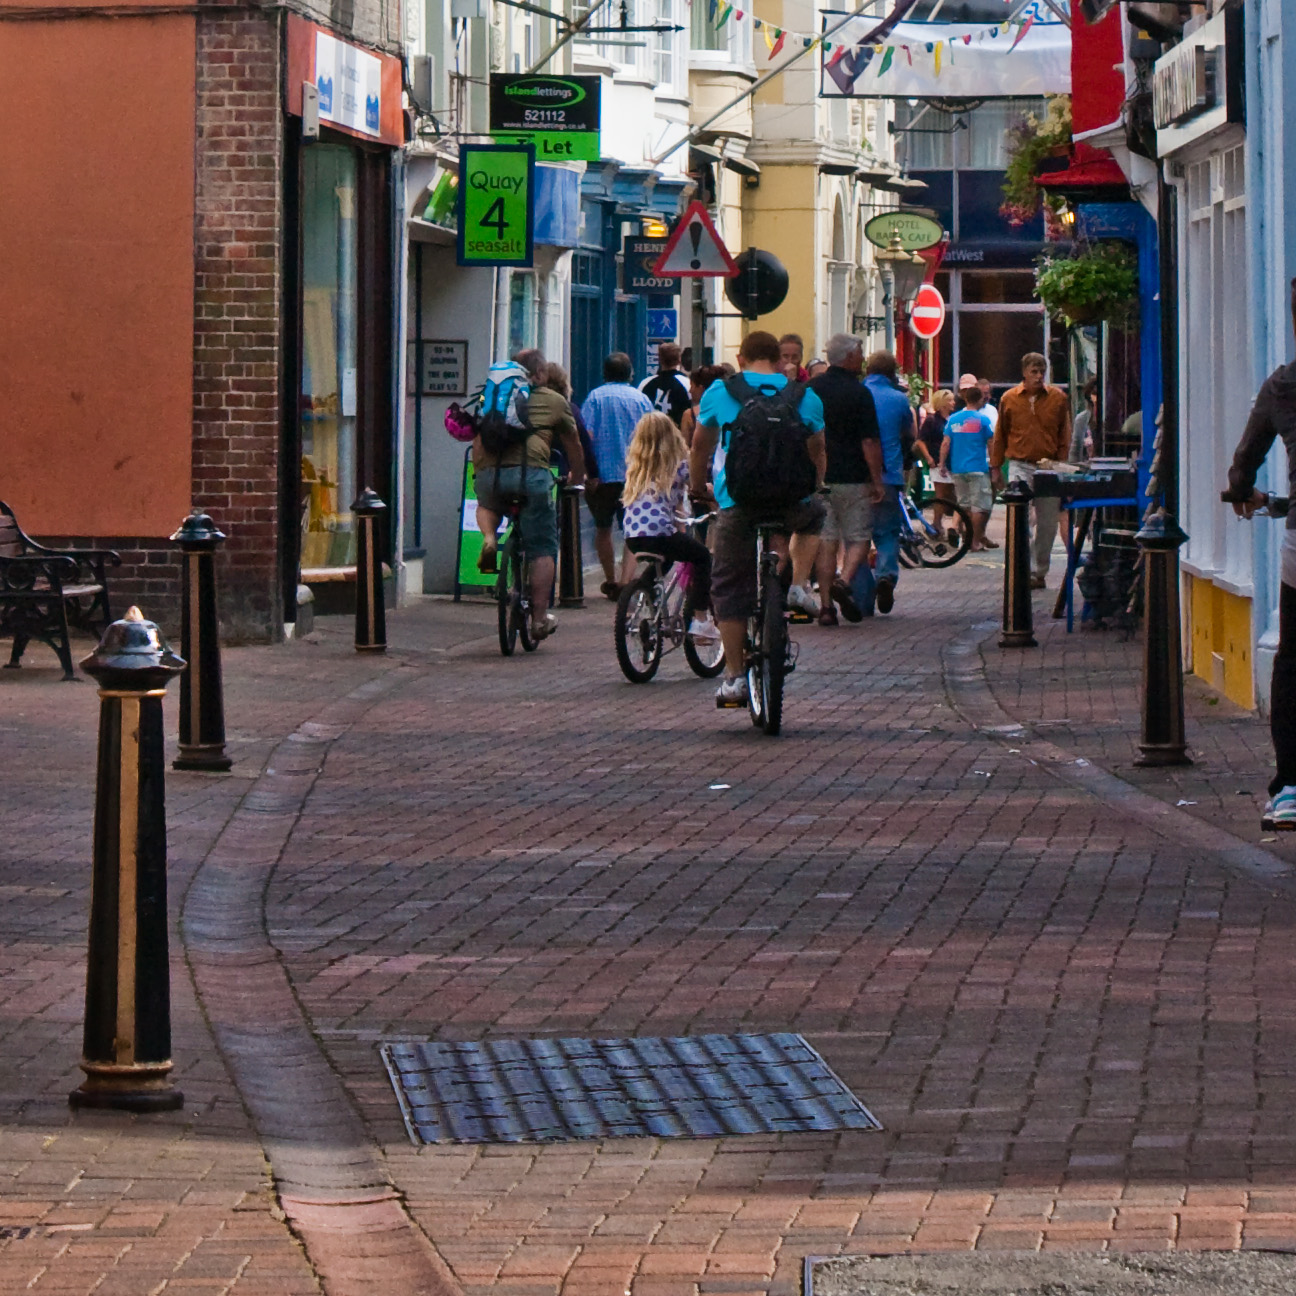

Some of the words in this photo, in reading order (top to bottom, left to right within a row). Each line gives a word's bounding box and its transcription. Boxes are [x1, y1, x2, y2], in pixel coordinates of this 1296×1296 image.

[504, 85, 572, 99] islandlettings
[524, 109, 566, 122] 521112
[542, 139, 573, 155] Let
[469, 170, 524, 195] Quay
[479, 196, 510, 241] 4
[887, 219, 921, 230] HOTEL
[467, 239, 523, 253] seasalt
[941, 248, 984, 261] atWest
[631, 276, 674, 288] LLOYD
